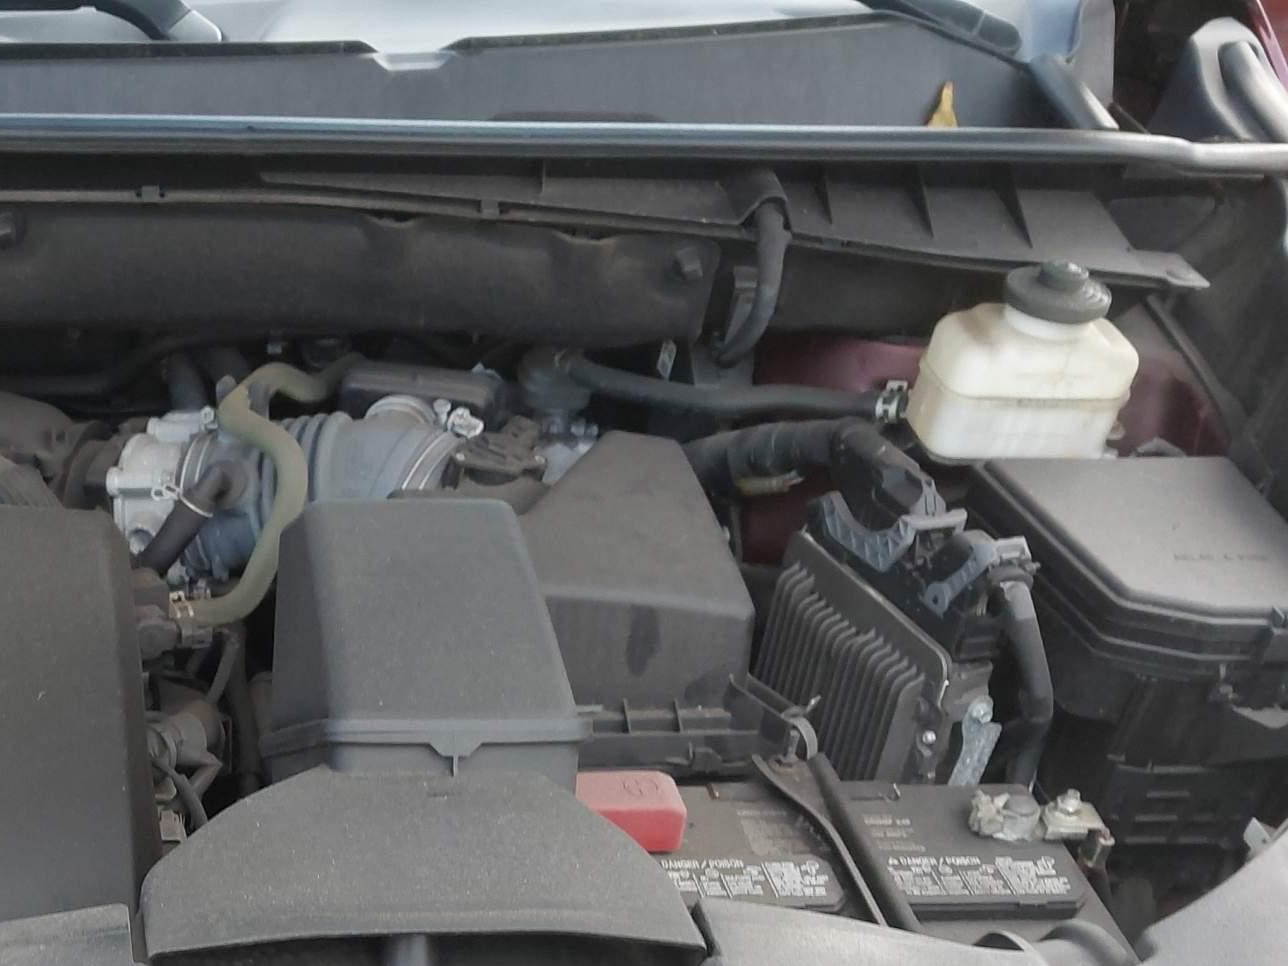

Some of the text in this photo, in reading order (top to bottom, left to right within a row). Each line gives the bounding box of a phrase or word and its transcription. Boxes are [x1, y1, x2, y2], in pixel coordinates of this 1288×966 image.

[660, 859, 700, 869] DANGER
[708, 859, 744, 869] POISON
[899, 856, 938, 865] DANGER
[945, 856, 981, 866] POISON
